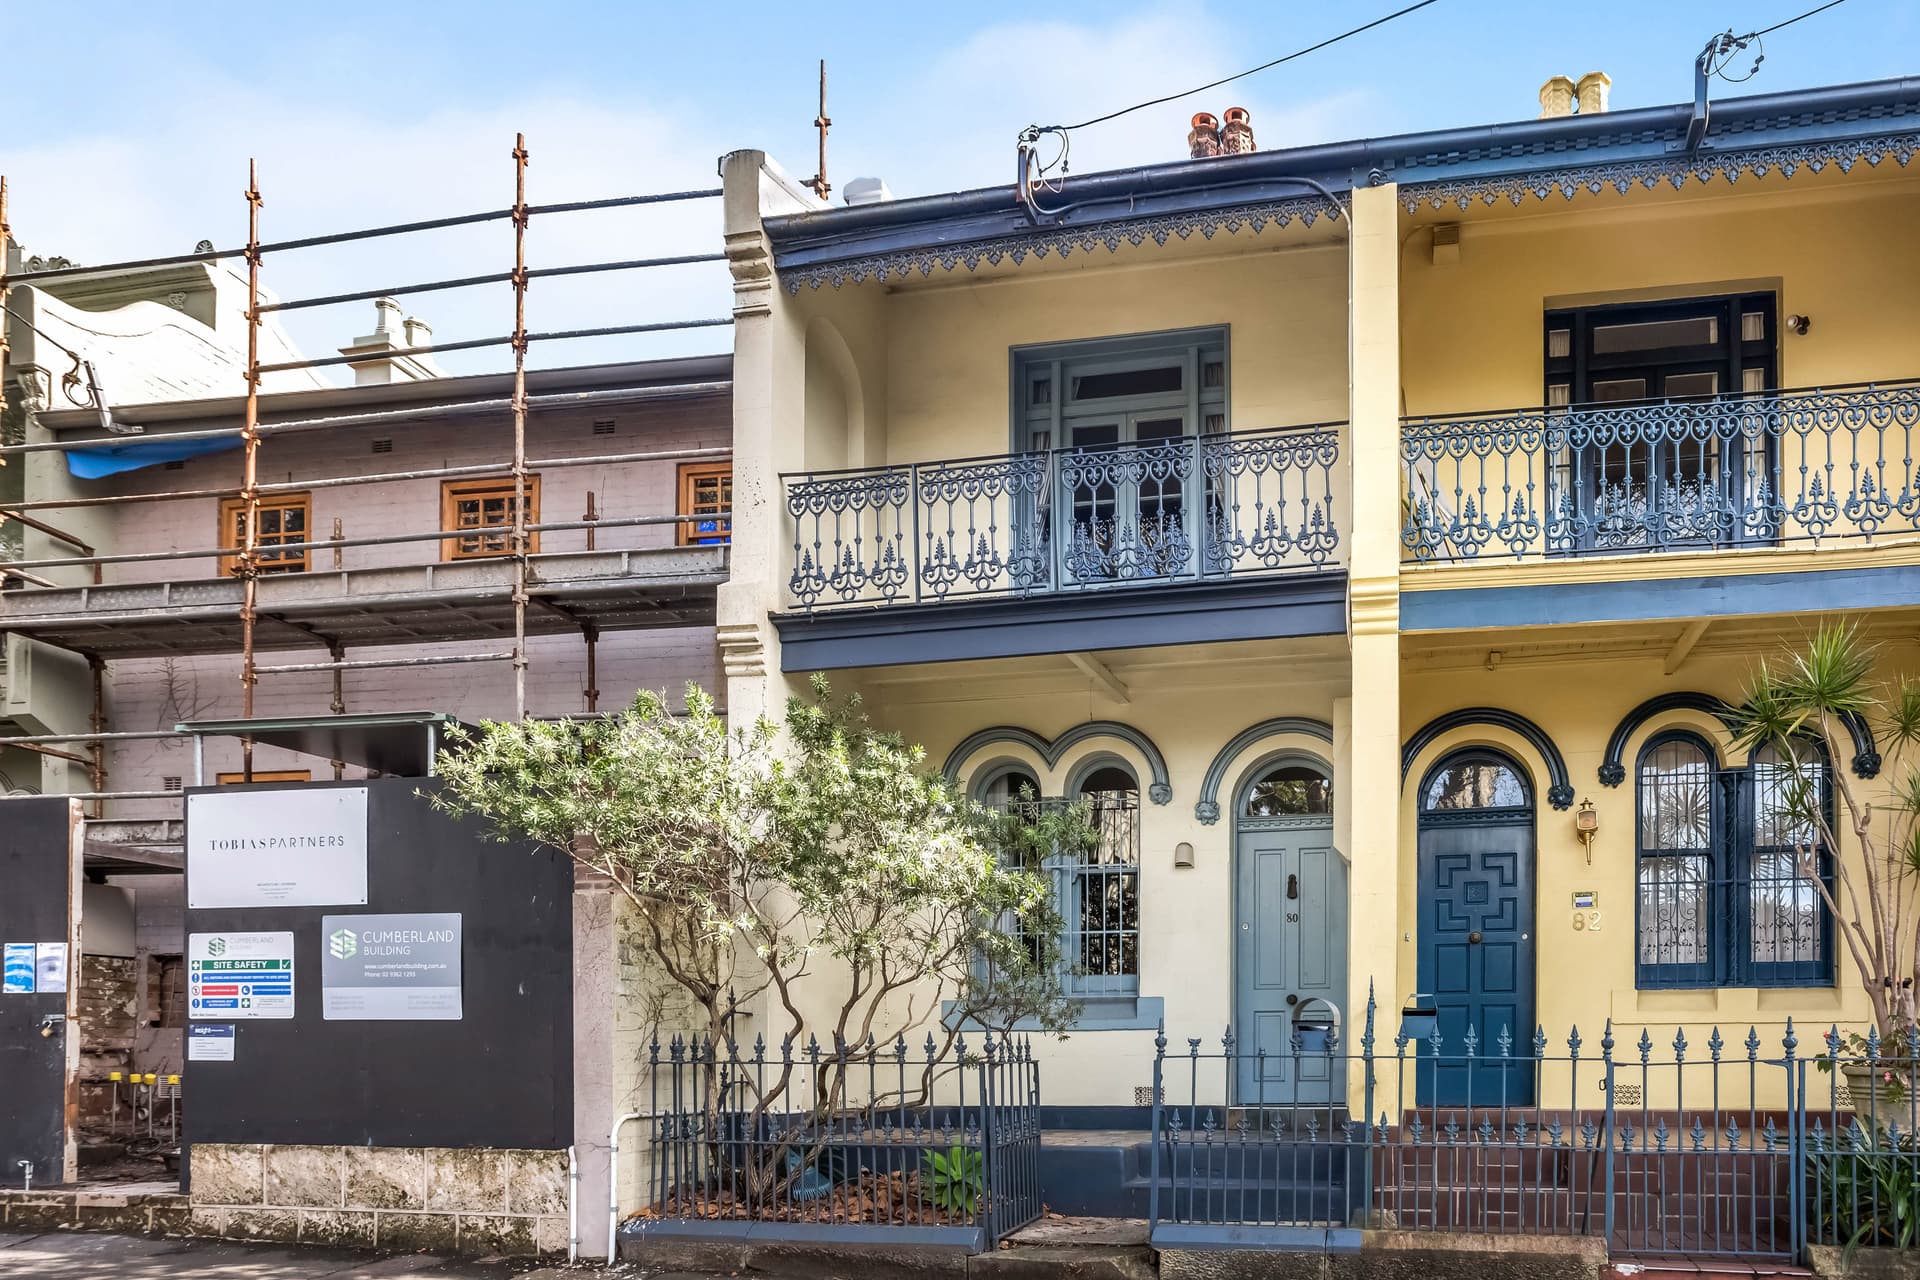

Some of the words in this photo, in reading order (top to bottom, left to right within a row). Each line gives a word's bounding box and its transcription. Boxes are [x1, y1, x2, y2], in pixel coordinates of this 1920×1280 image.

[1286, 912, 1298, 923] 80
[1572, 911, 1601, 931] 82
[362, 930, 454, 943] CUMBERLAND
[363, 946, 411, 956] BUILDING
[213, 961, 232, 969] SITE
[234, 961, 267, 969] SAFETY
